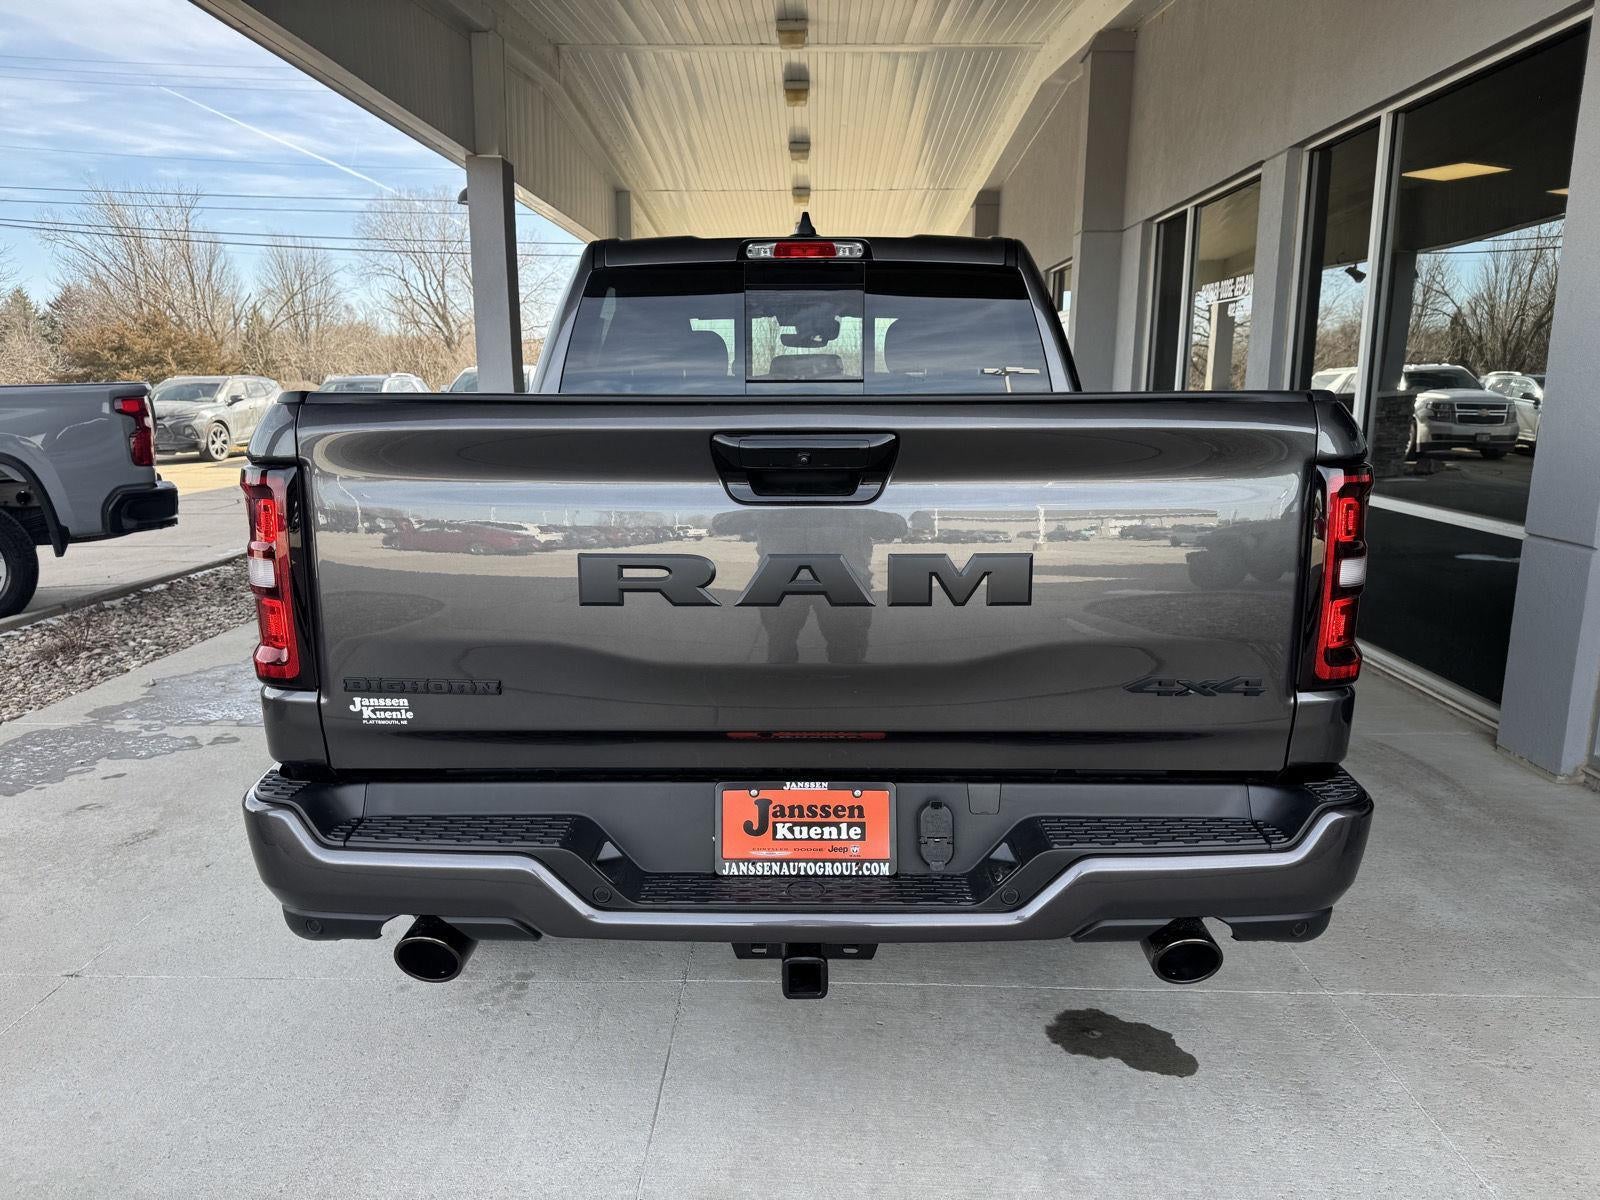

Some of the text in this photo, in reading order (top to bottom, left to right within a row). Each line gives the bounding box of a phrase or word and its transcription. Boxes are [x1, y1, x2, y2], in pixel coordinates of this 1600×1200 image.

[577, 553, 1034, 607] RAM
[349, 696, 409, 712] Janssen
[361, 706, 414, 719] Kuenle
[783, 781, 829, 790] JANSSEN
[743, 798, 866, 837] Janssen
[775, 822, 862, 840] Kuenle
[827, 845, 849, 854] Jeep
